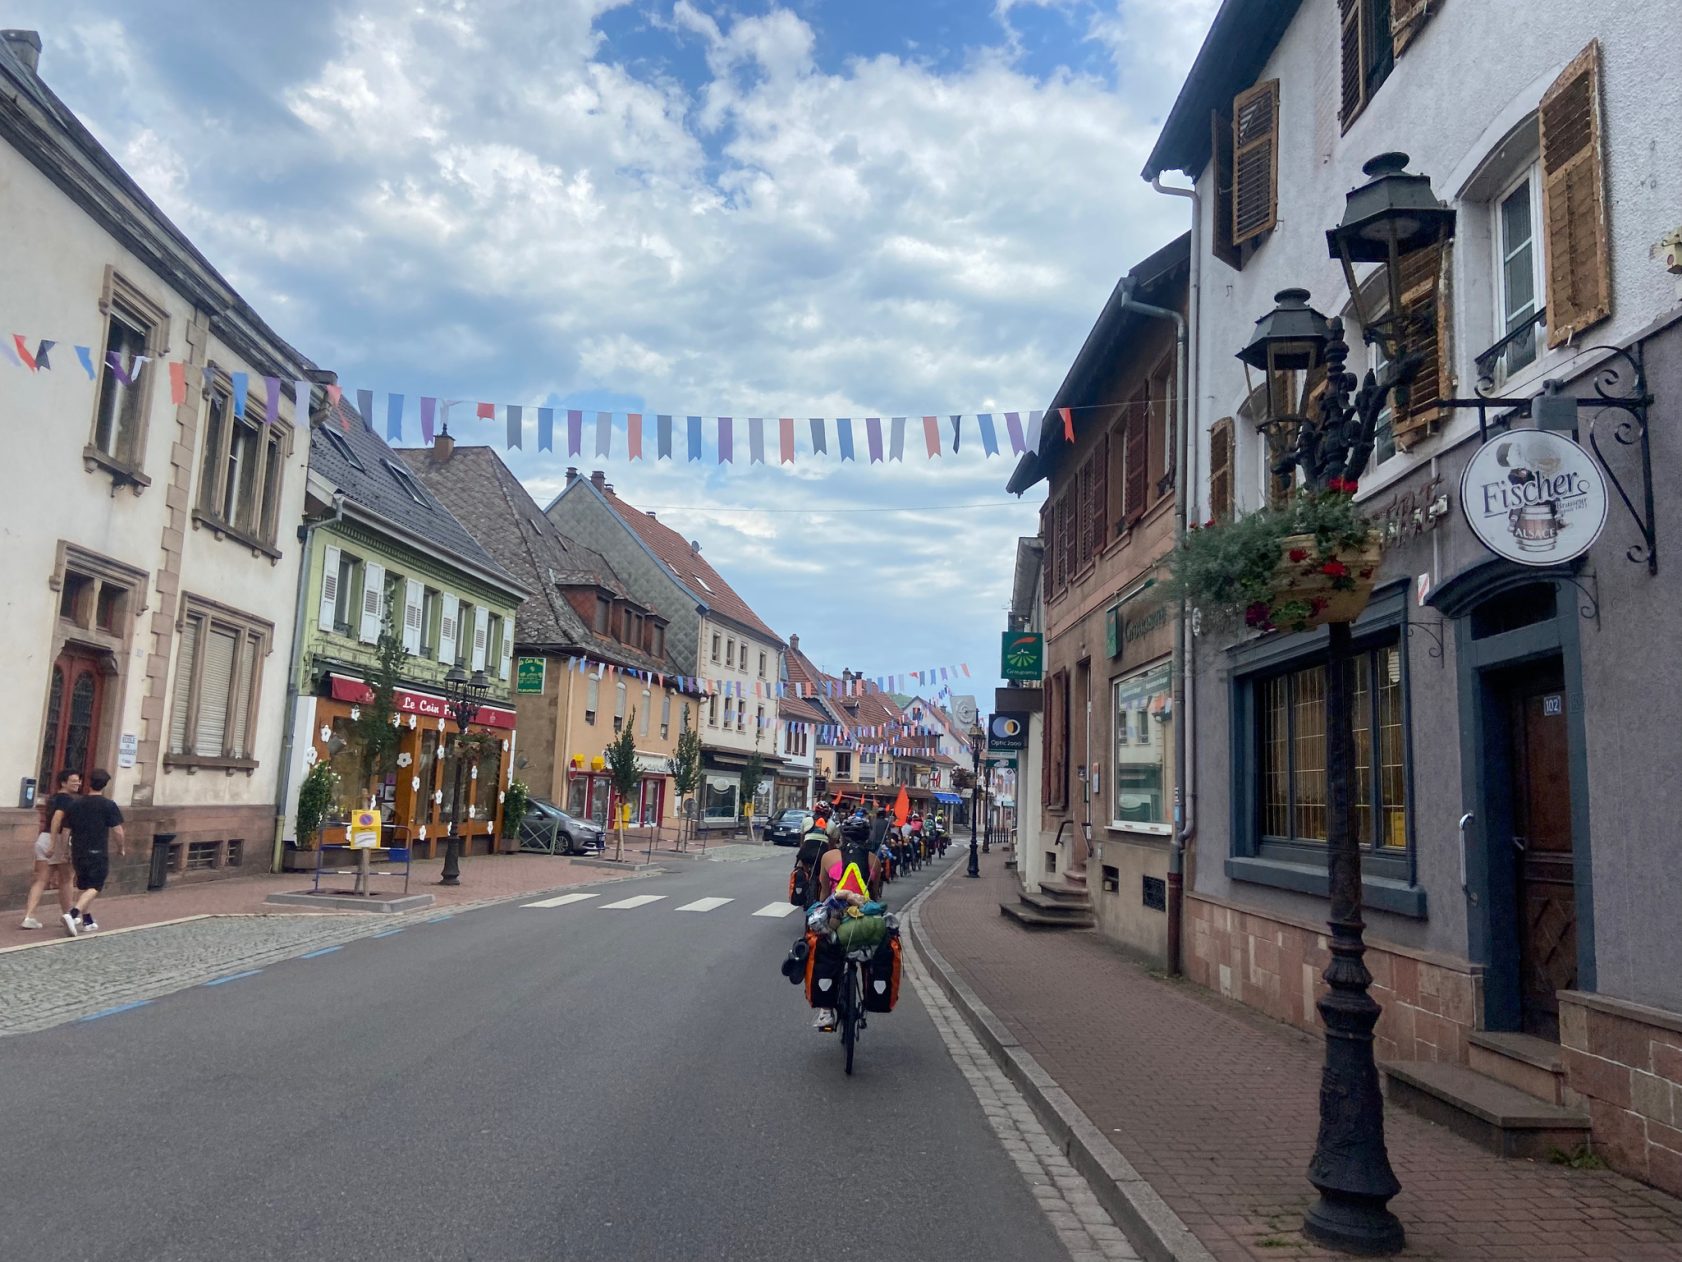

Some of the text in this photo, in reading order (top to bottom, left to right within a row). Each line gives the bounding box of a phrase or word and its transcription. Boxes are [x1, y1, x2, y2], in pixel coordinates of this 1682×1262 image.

[1480, 471, 1578, 513] Fischer
[1515, 528, 1556, 539] ALSACE
[403, 697, 415, 709] Le
[419, 699, 440, 715] Coin
[1546, 699, 1558, 712] 102
